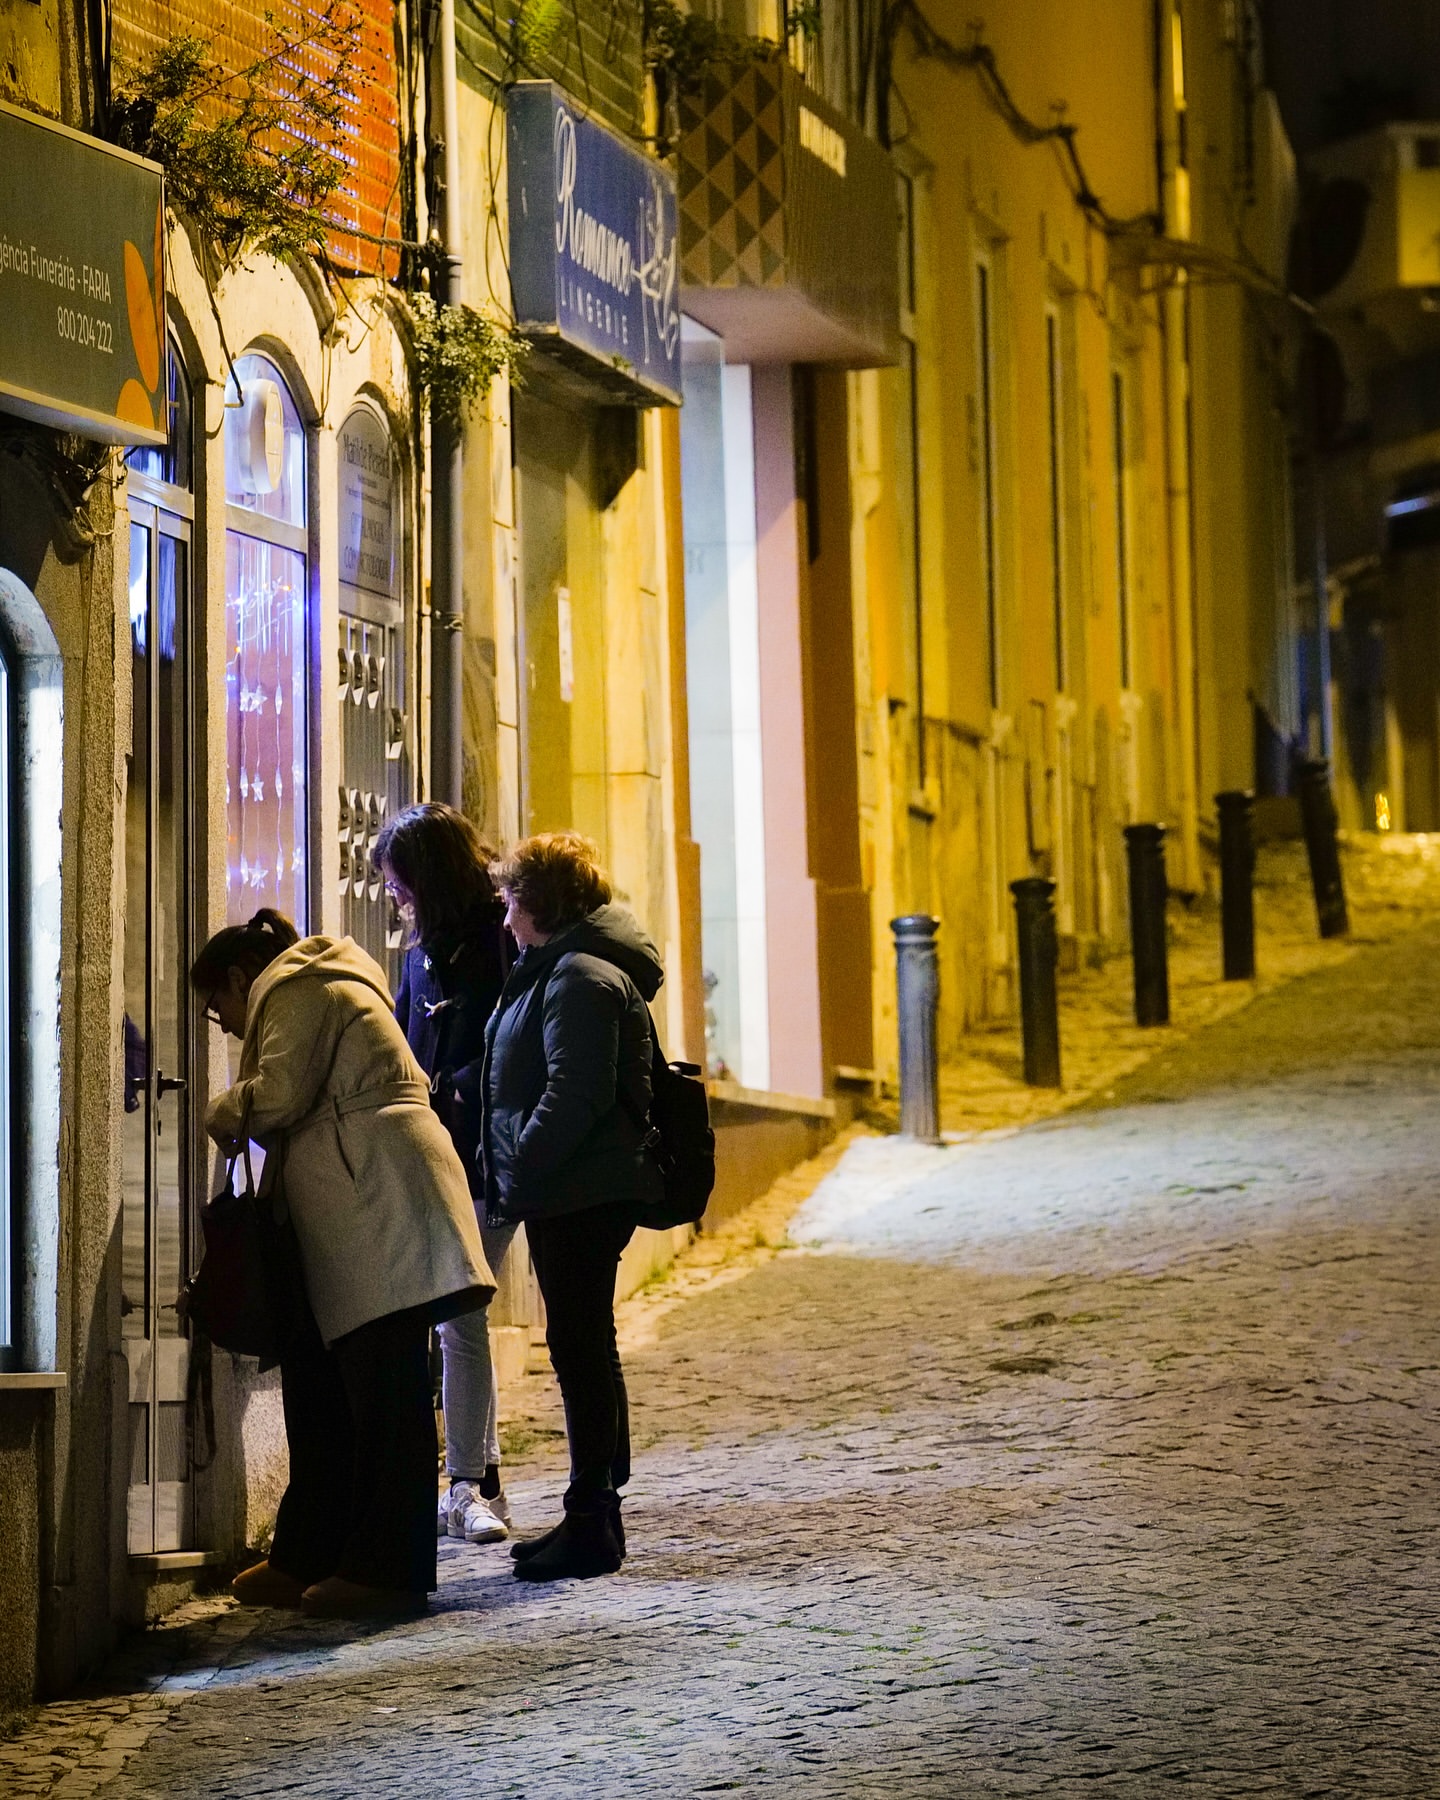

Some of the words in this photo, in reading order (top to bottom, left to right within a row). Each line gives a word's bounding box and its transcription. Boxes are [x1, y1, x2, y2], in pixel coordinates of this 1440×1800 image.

[31, 245, 75, 291] Funerária
[83, 264, 111, 305] FARIA
[57, 305, 76, 342] 800
[77, 312, 96, 348] 204
[96, 319, 114, 355] 222
[561, 275, 628, 345] LINGERIE
